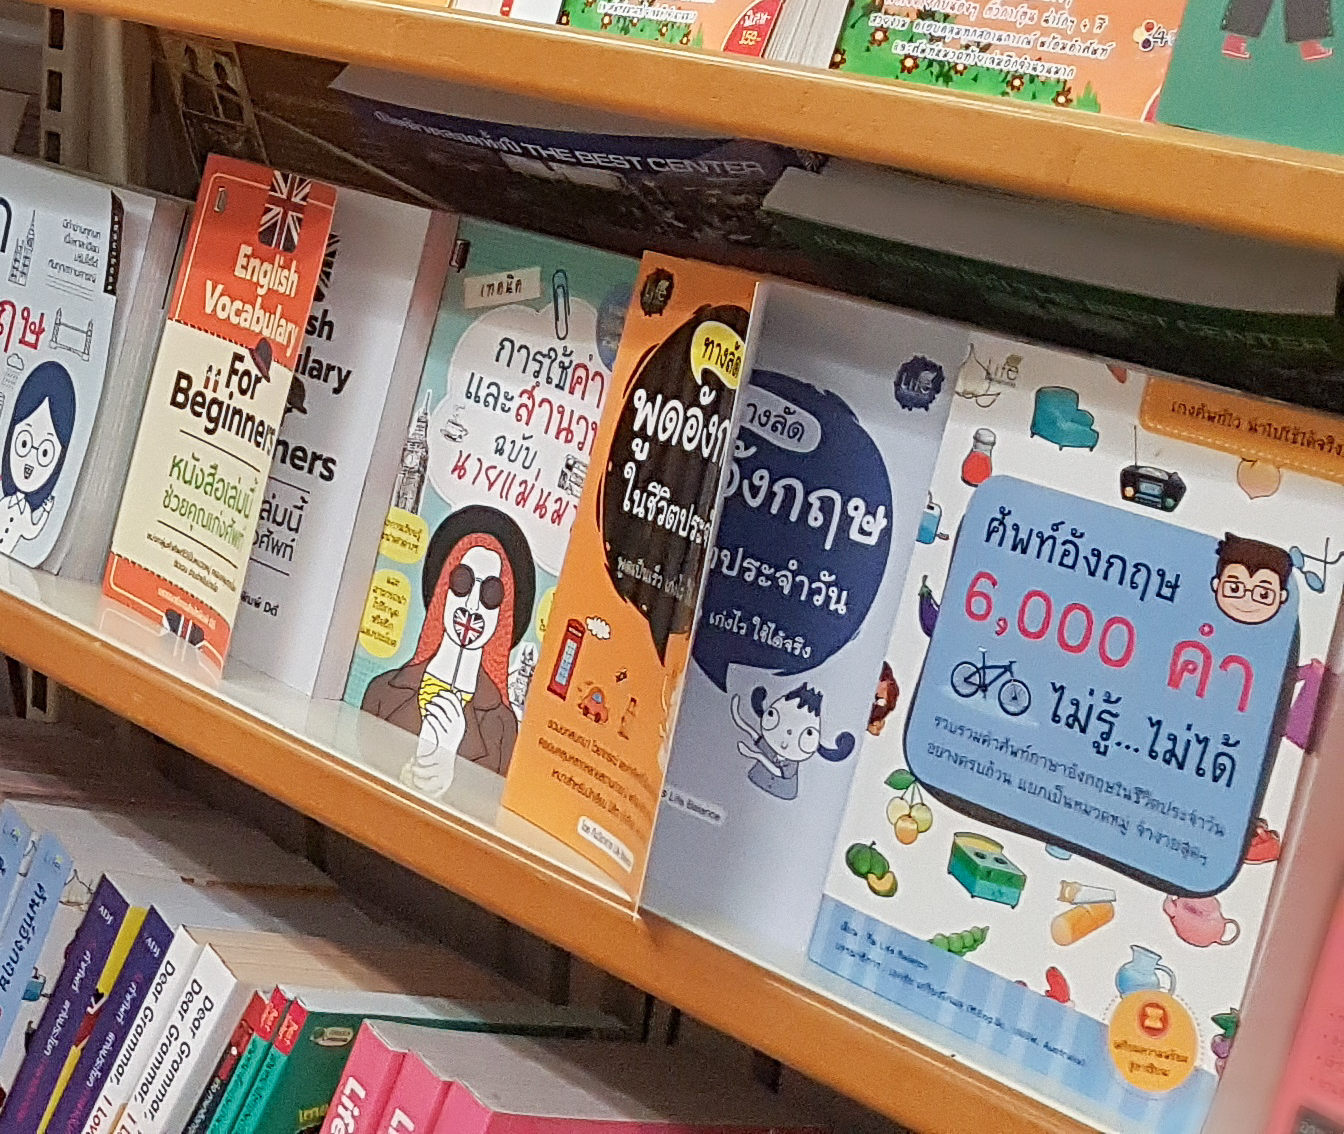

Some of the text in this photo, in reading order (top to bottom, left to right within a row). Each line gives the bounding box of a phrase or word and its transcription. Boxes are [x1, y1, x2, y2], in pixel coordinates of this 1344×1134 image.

[522, 142, 768, 176] THE BEST CENTER
[233, 243, 300, 298] English
[480, 274, 523, 299] เทคนิค
[204, 279, 300, 358] Vocabulary
[225, 352, 262, 402] For
[169, 370, 276, 456] Beginners
[494, 433, 538, 470] ฉบับ
[162, 484, 247, 552] ช่วยคุณเก่งศัพท์
[169, 453, 260, 519] หนังสือเล่มนี้
[985, 506, 1182, 603] ศัพท์อังกฤษ
[964, 571, 1256, 714] 6,000 คำ
[0, 881, 49, 993] ศัพท์อังกฤษ
[152, 959, 177, 1004] Dear
[178, 978, 204, 1022] Dear
[108, 1005, 156, 1086] Grammar,
[133, 1025, 181, 1104] Grammar,
[142, 995, 215, 1122] Dear Grammar,
